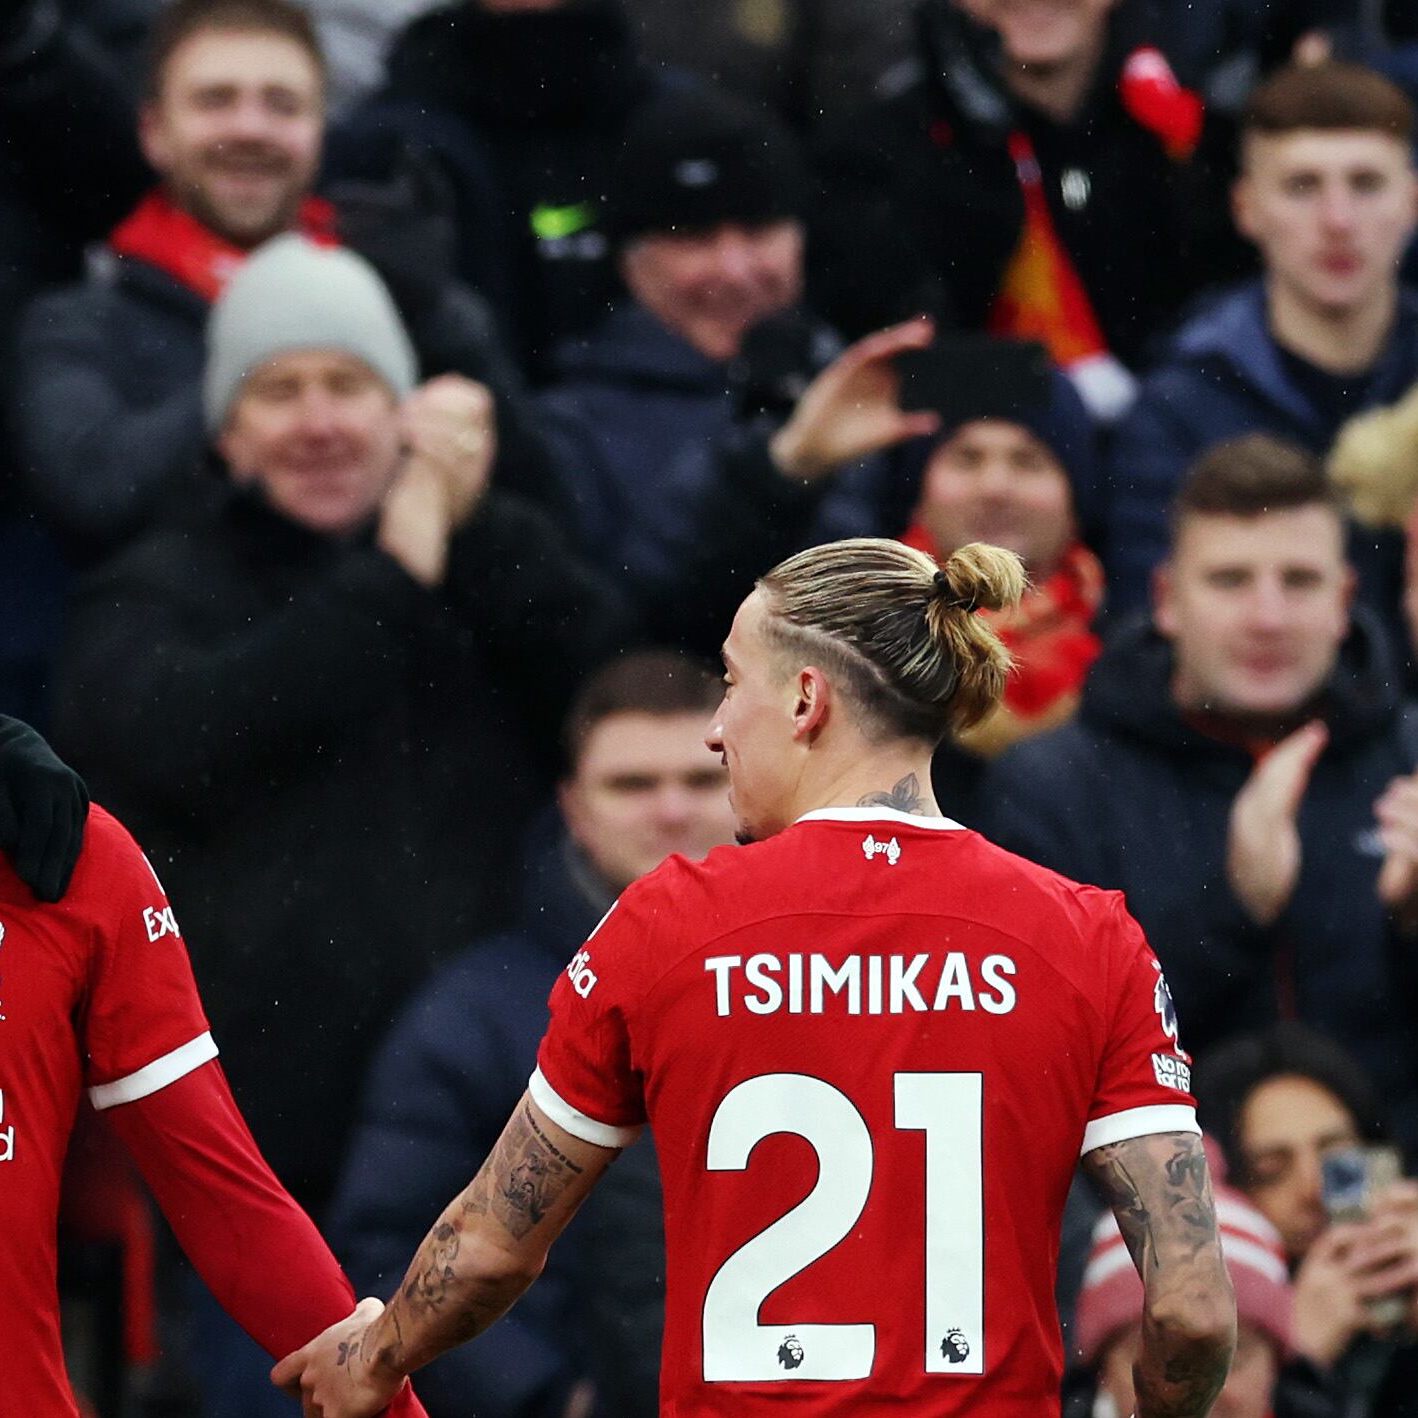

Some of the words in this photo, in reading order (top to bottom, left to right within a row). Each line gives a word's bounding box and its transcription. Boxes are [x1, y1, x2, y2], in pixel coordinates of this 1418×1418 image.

[704, 951, 1018, 1017] TSIMIKAS
[1151, 1052, 1176, 1075] No
[702, 1072, 985, 1383] 21
